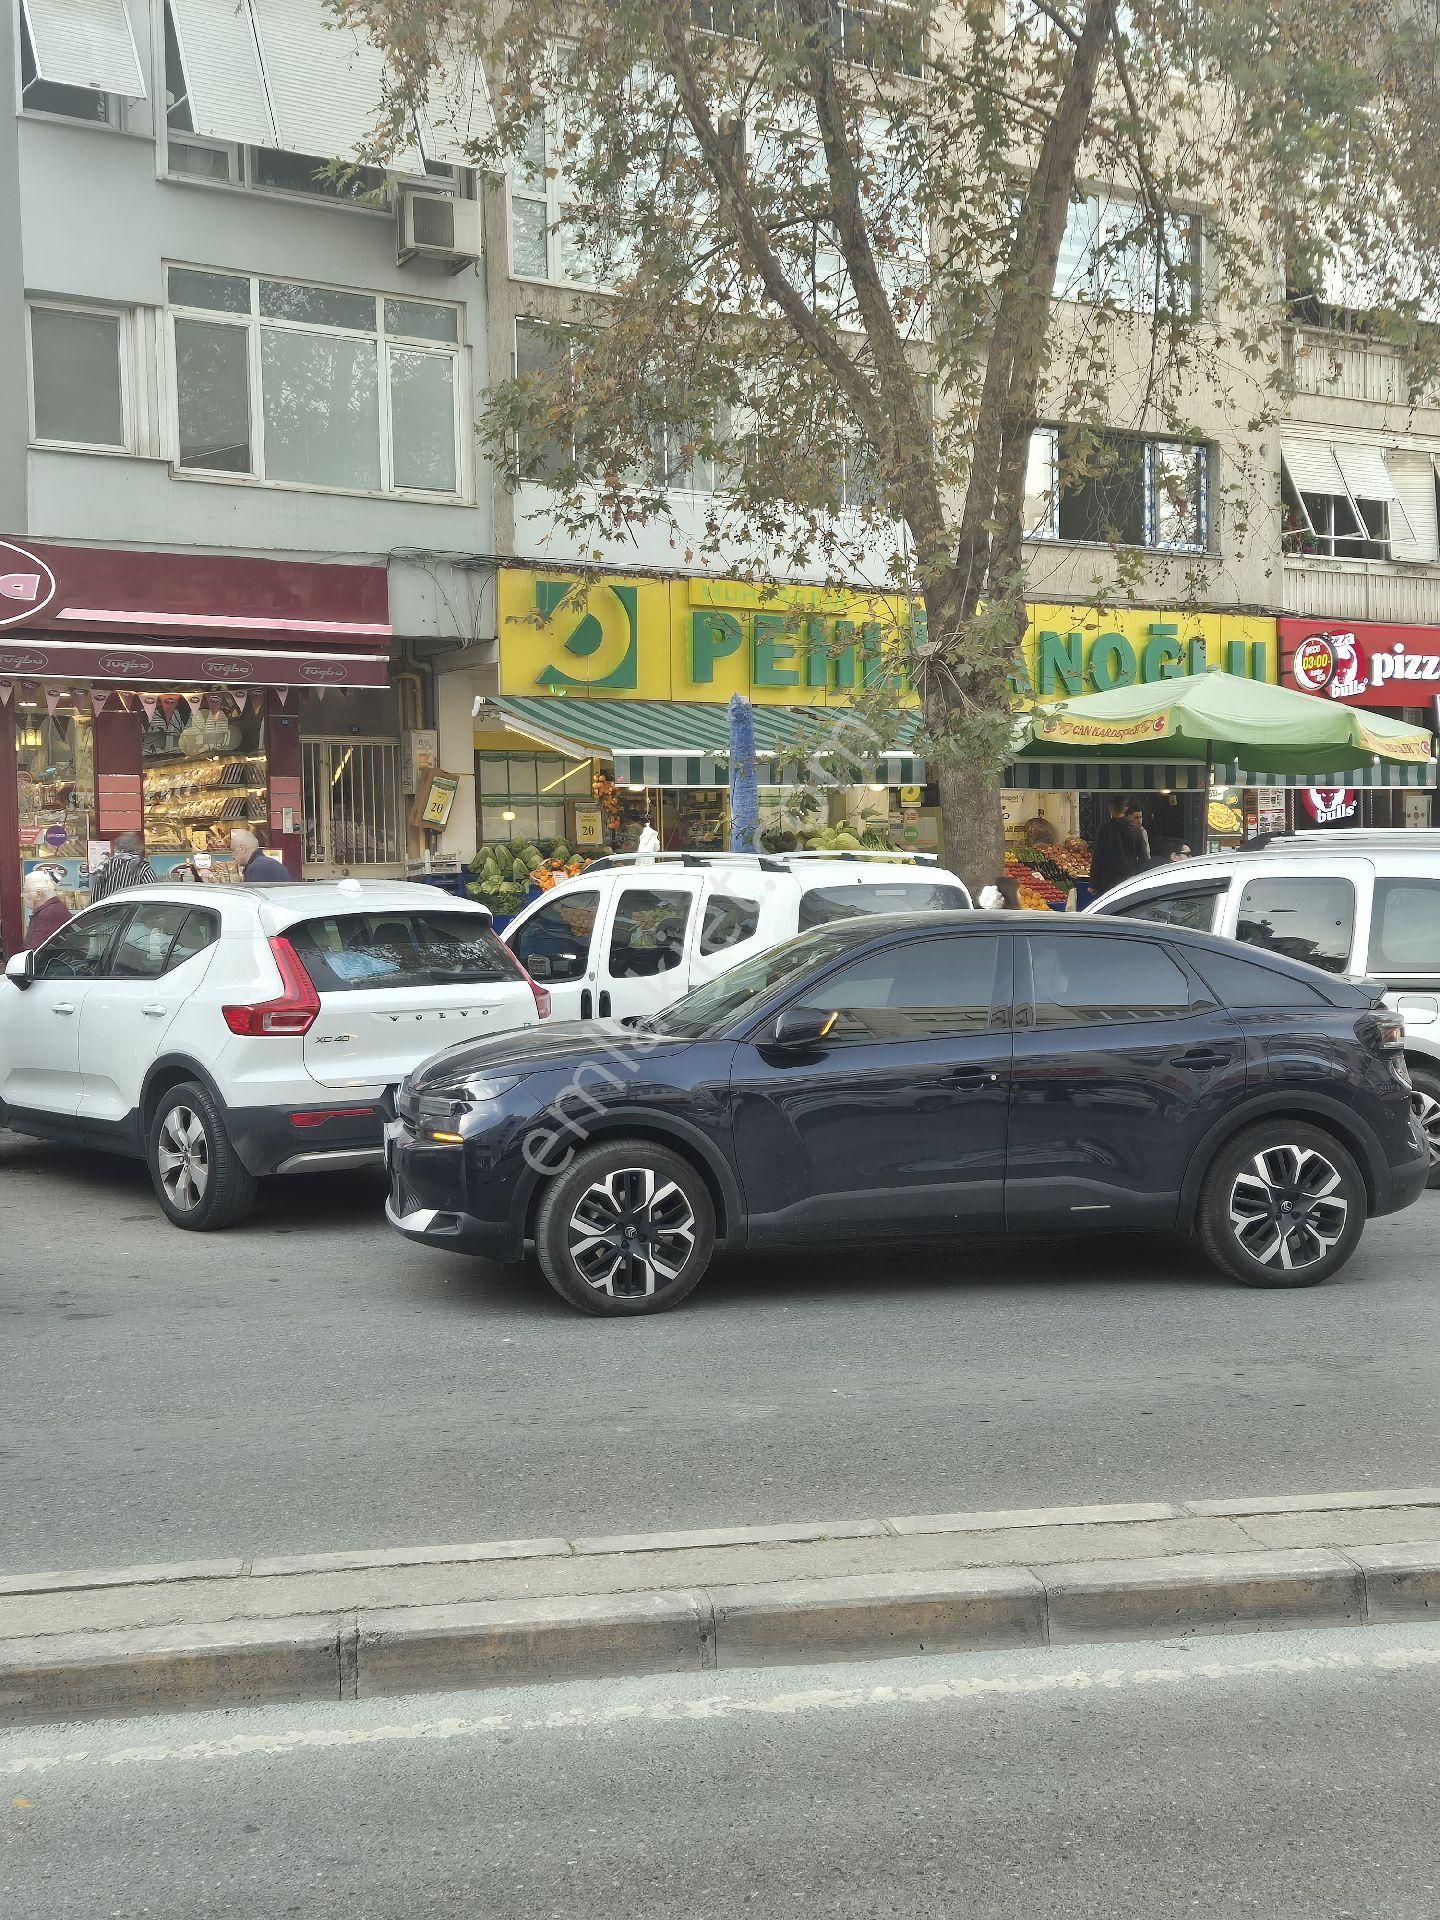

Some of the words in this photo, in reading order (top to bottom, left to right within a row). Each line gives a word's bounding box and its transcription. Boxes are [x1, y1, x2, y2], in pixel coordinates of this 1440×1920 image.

[1303, 654, 1328, 670] 03:00
[1331, 679, 1365, 698] bulls
[431, 802, 443, 814] 20
[1317, 802, 1355, 823] bulls
[582, 826, 594, 836] 20
[389, 1009, 489, 1022] VOLVO
